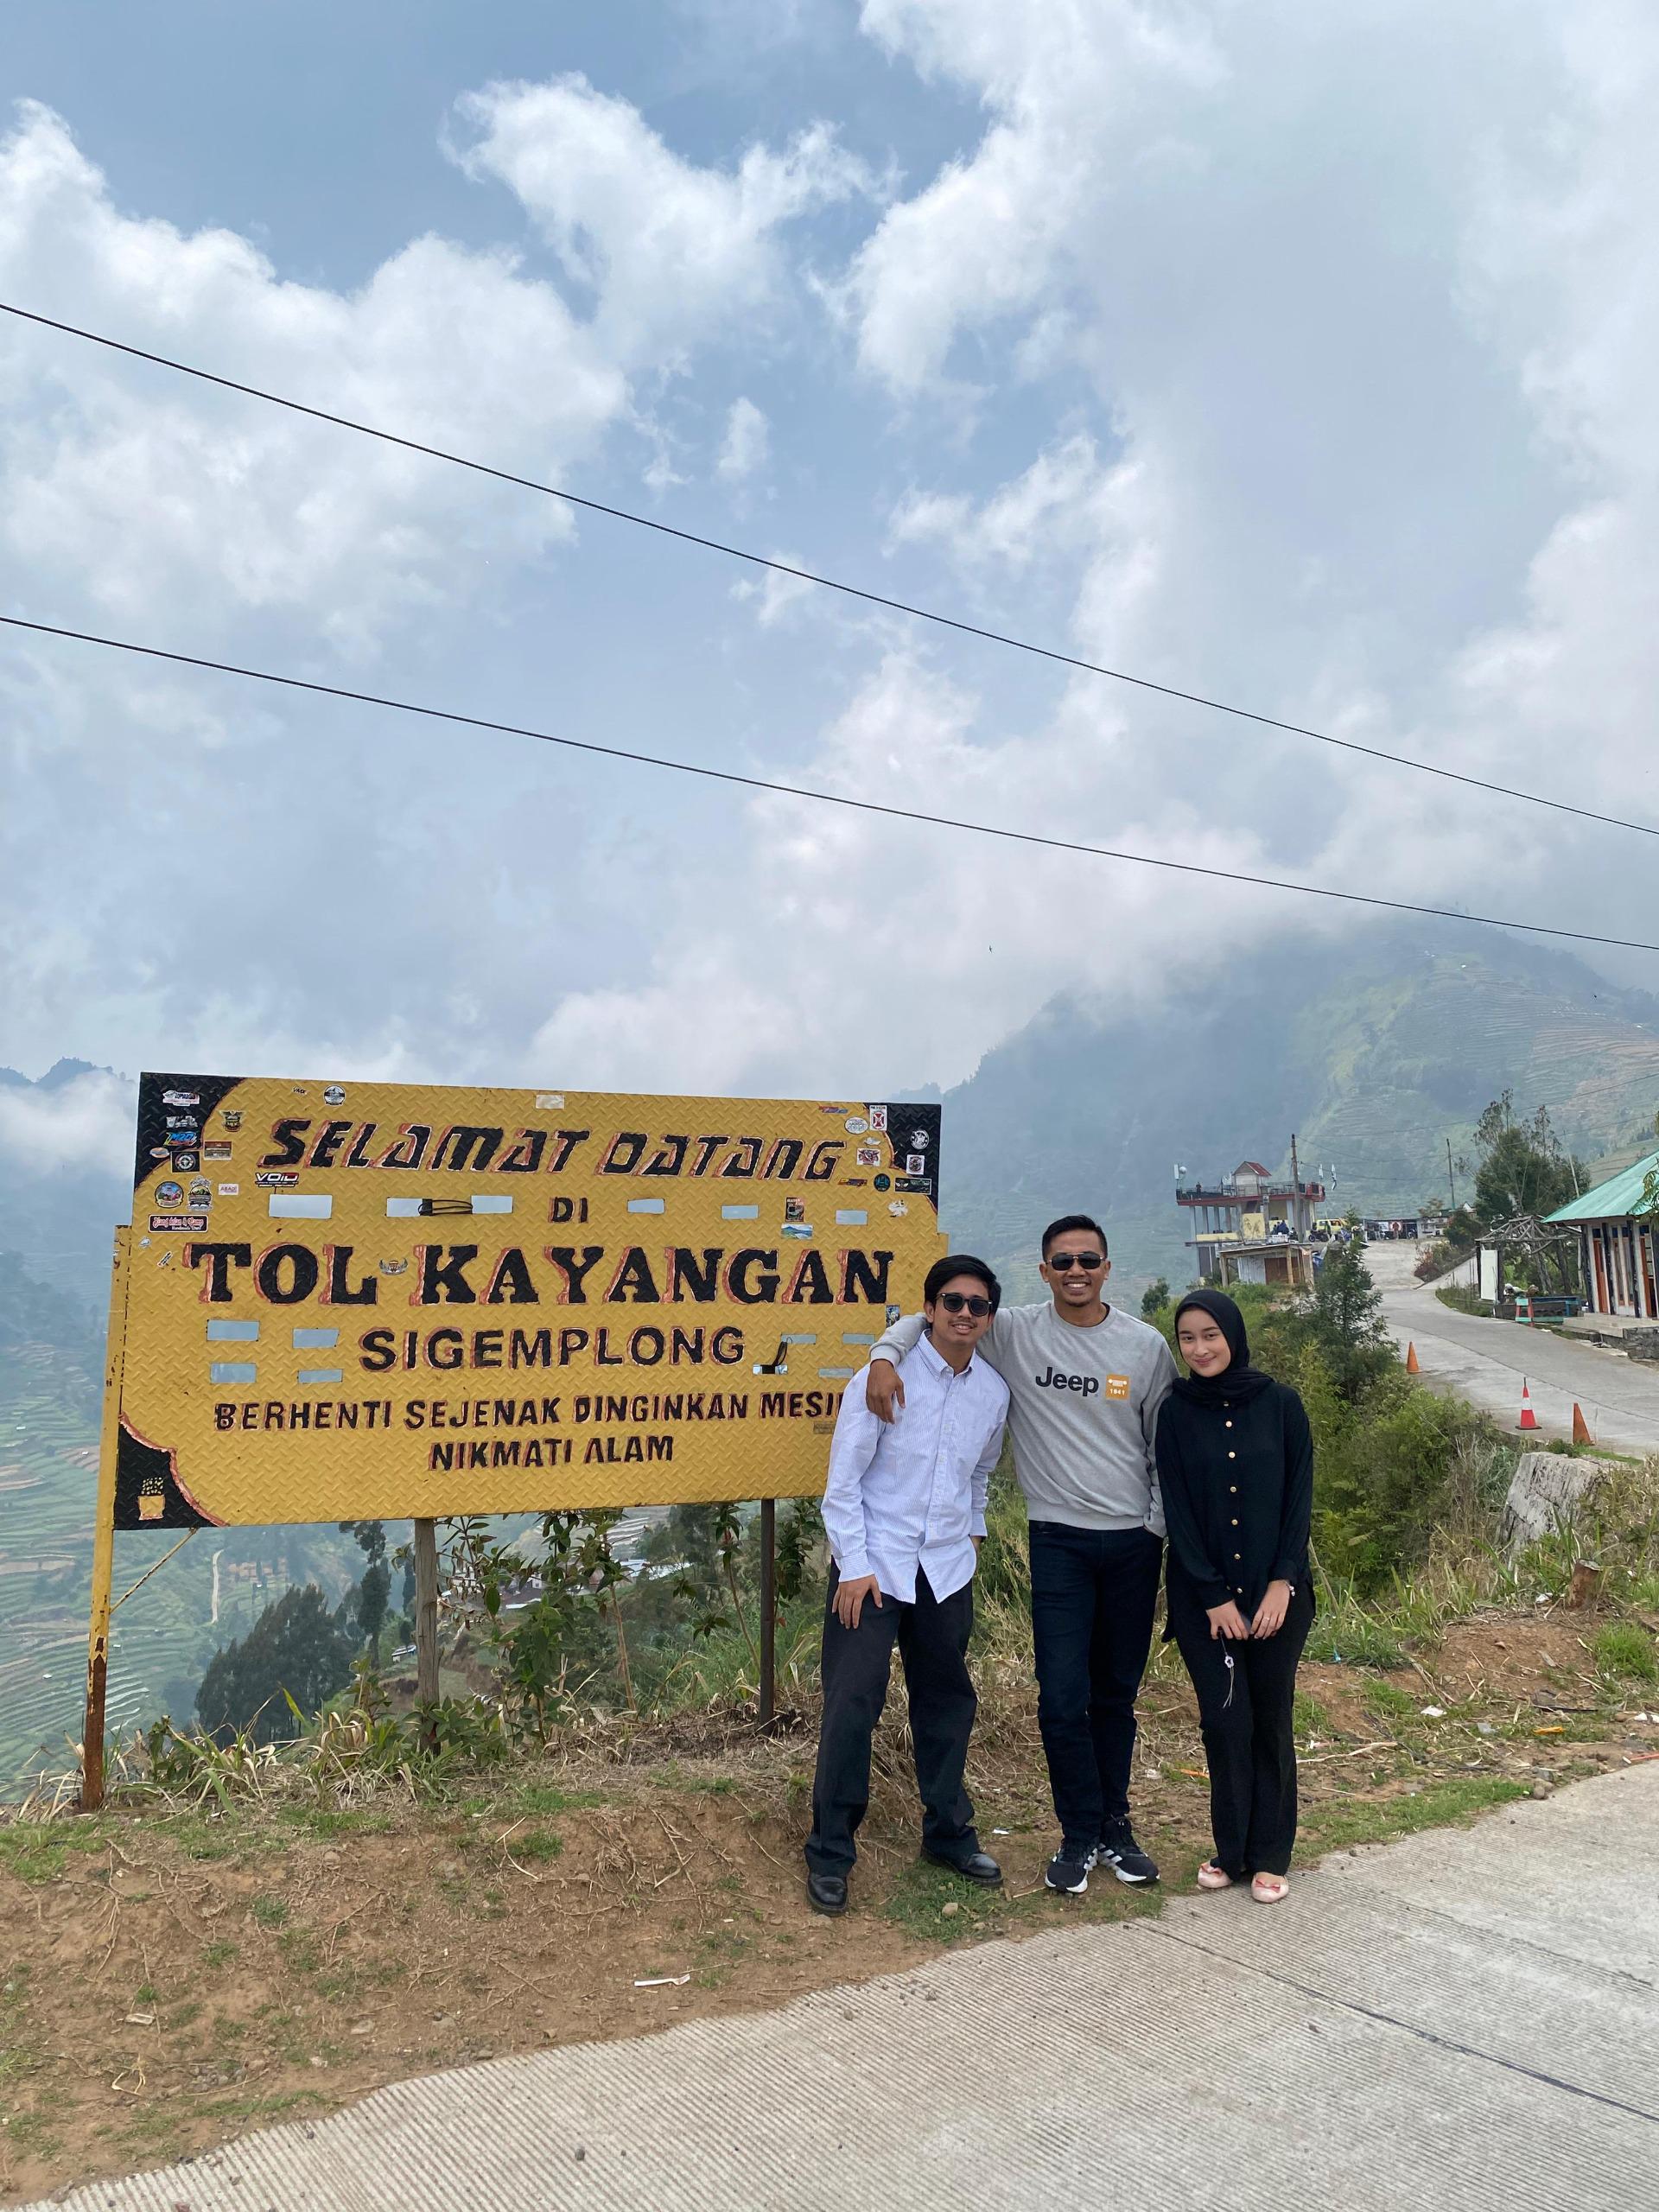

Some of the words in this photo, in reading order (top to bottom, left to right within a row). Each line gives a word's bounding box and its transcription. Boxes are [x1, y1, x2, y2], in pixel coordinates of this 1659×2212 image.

[257, 1117, 591, 1173] SELAMAT
[594, 1132, 847, 1181] DATANG
[549, 1197, 588, 1224] DI
[182, 1242, 378, 1306] TOL
[409, 1243, 894, 1306] KAYANGAN
[359, 1325, 746, 1372] SIGEMPLONG
[1035, 1366, 1100, 1397] Jeep
[214, 1400, 392, 1431] BERHENTI
[404, 1395, 562, 1430] SEJENAK
[573, 1391, 749, 1425] DINGINKAN
[429, 1438, 573, 1471] NIKMATI
[583, 1435, 674, 1465] ALAM
